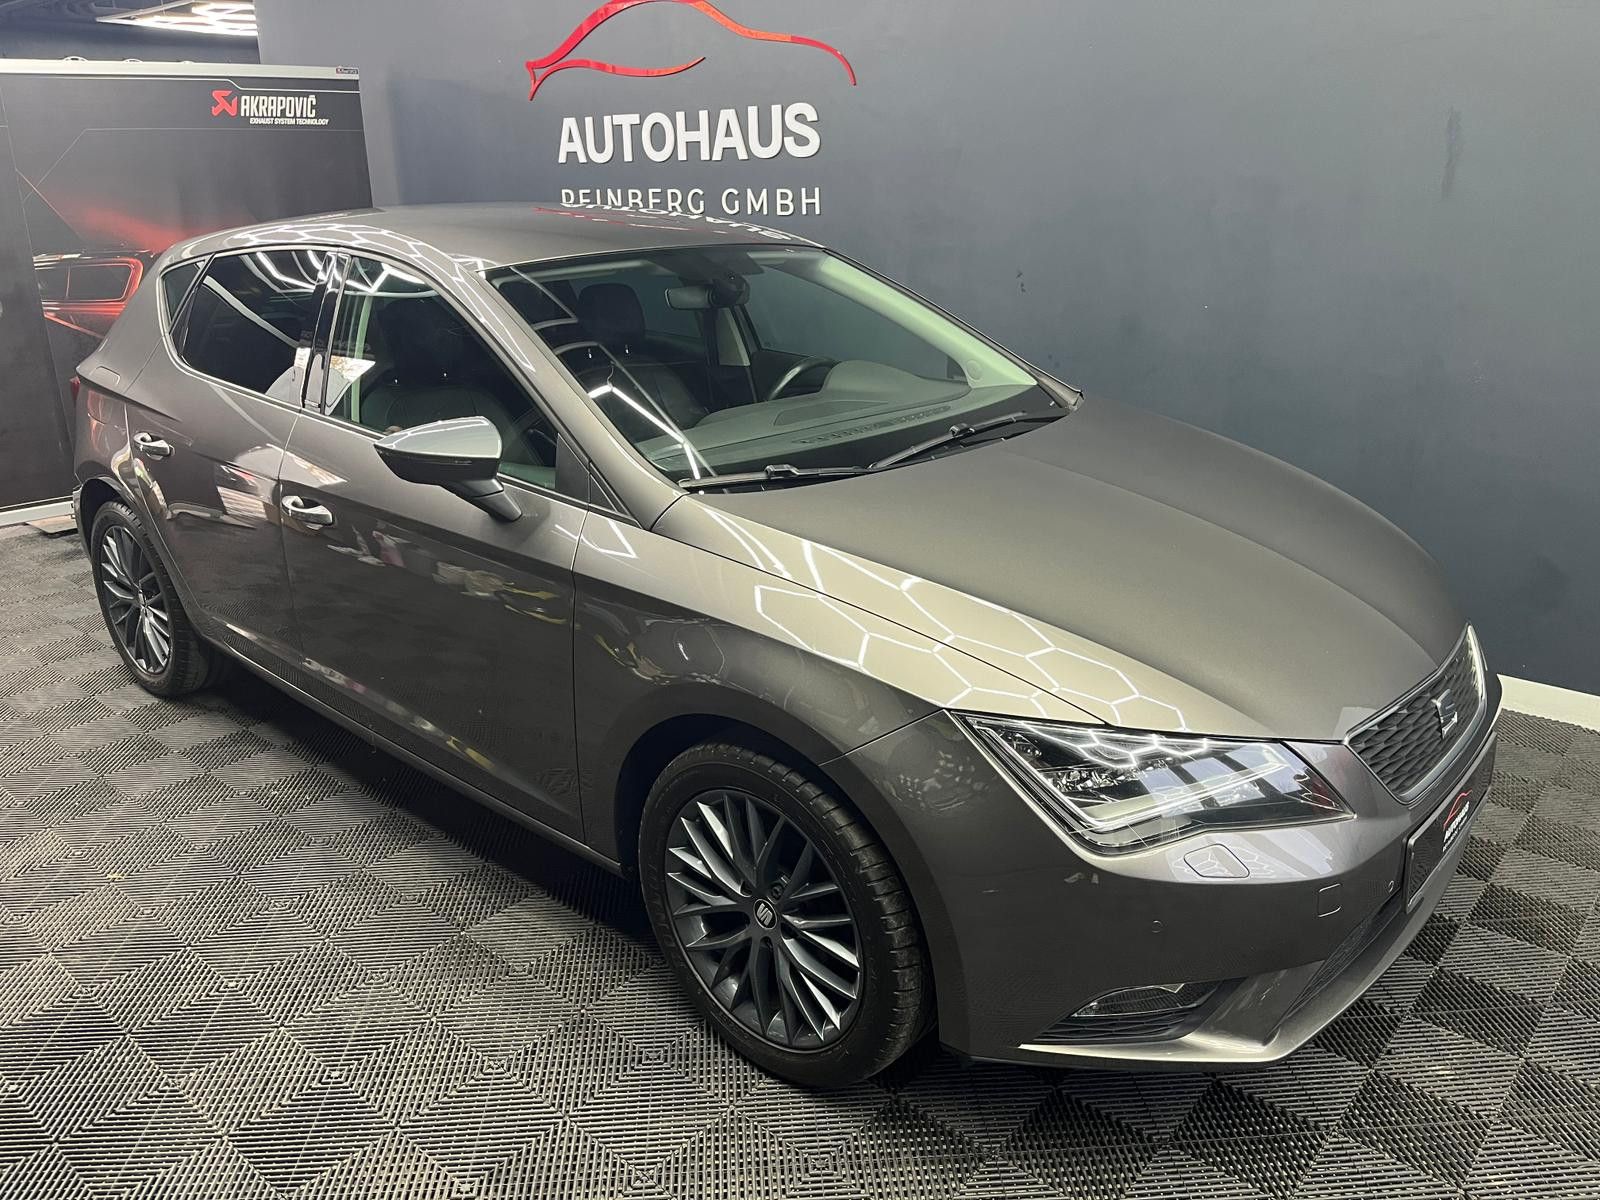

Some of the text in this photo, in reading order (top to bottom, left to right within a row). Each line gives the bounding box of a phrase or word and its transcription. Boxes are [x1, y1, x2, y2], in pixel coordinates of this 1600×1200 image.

[241, 94, 316, 118] AKRAPOVIČ
[249, 117, 274, 125] EXHAUST
[296, 118, 330, 126] TECHNOLOGY
[558, 102, 821, 164] AUTOHAUS
[721, 186, 821, 216] GMBH
